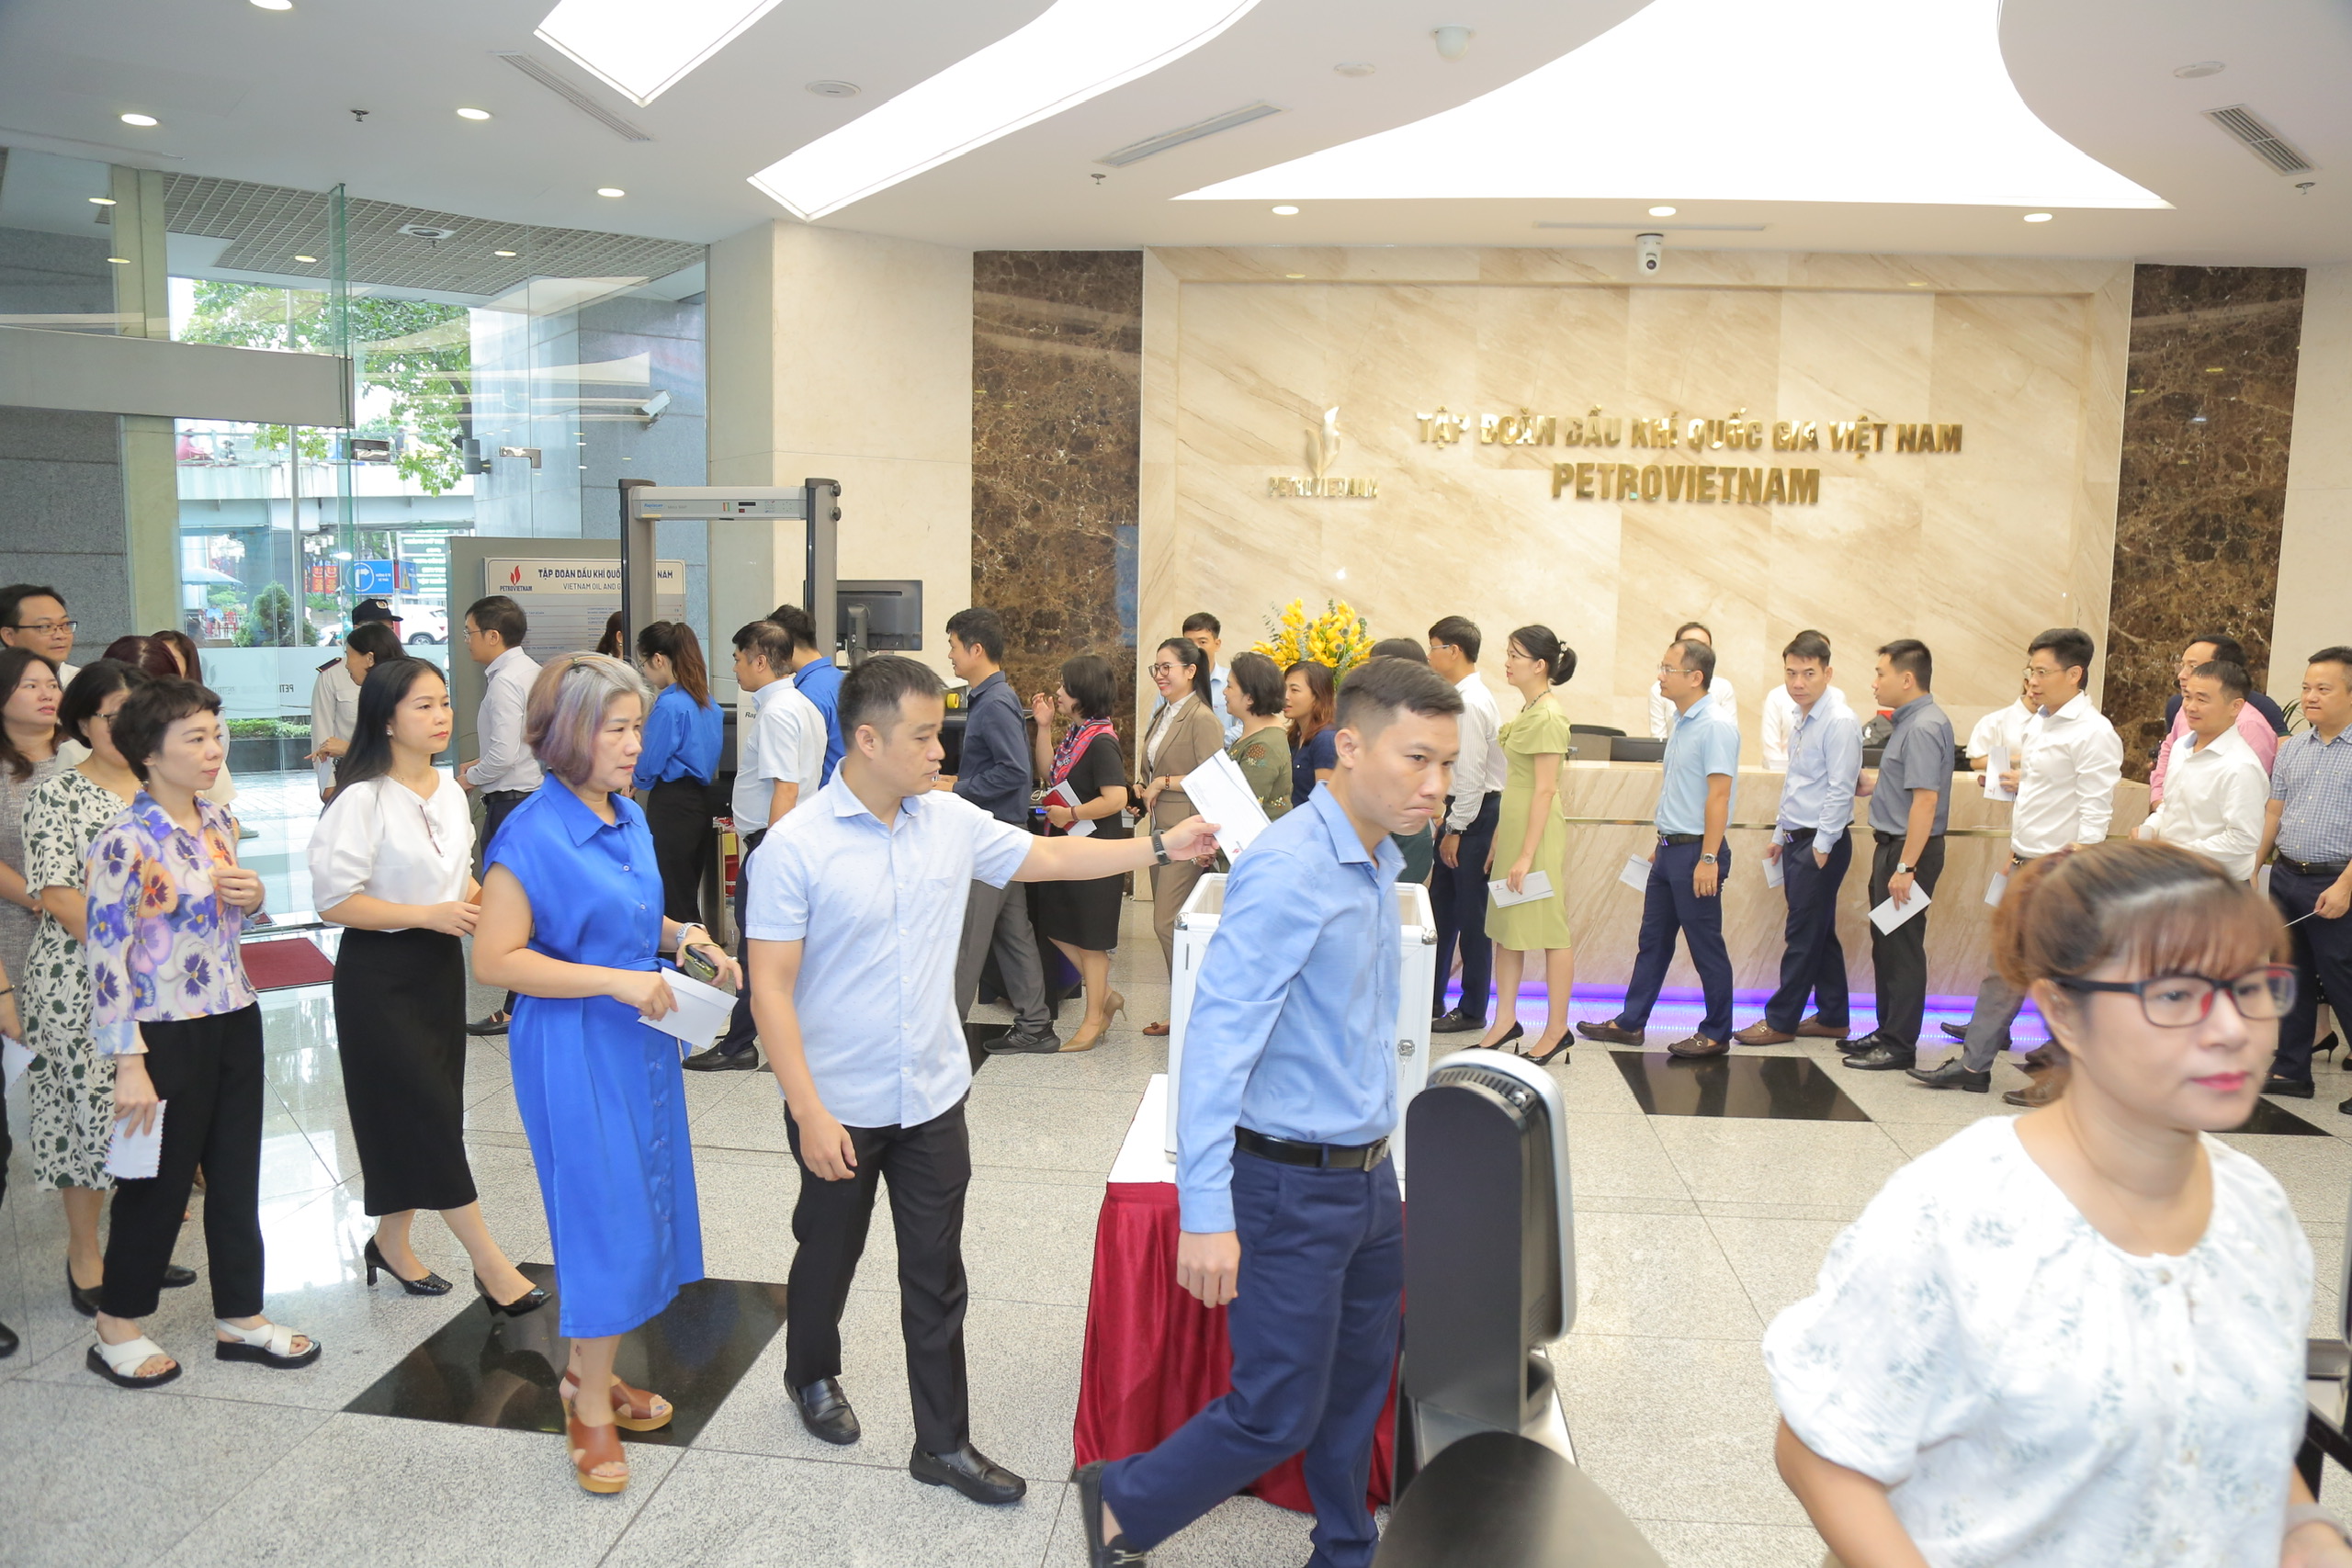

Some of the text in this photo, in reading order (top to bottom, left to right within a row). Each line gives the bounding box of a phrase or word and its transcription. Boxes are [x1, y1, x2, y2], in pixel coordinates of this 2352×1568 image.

[1416, 405, 1470, 448] TẬP
[1480, 407, 1556, 446] ĐOÀN
[1631, 411, 1679, 448] KHÍ
[1687, 407, 1763, 453] QUỐC
[1772, 420, 1819, 452] GIA
[1828, 415, 1888, 459] VIỆT
[1895, 423, 1962, 453] NAM
[1269, 477, 1378, 499] PETROVIETNAM
[1552, 462, 1820, 504] PETROVIETNAM
[657, 570, 673, 579] NAM
[563, 582, 591, 591] VIETNAM
[593, 582, 602, 591] OIL
[603, 582, 616, 591] AND
